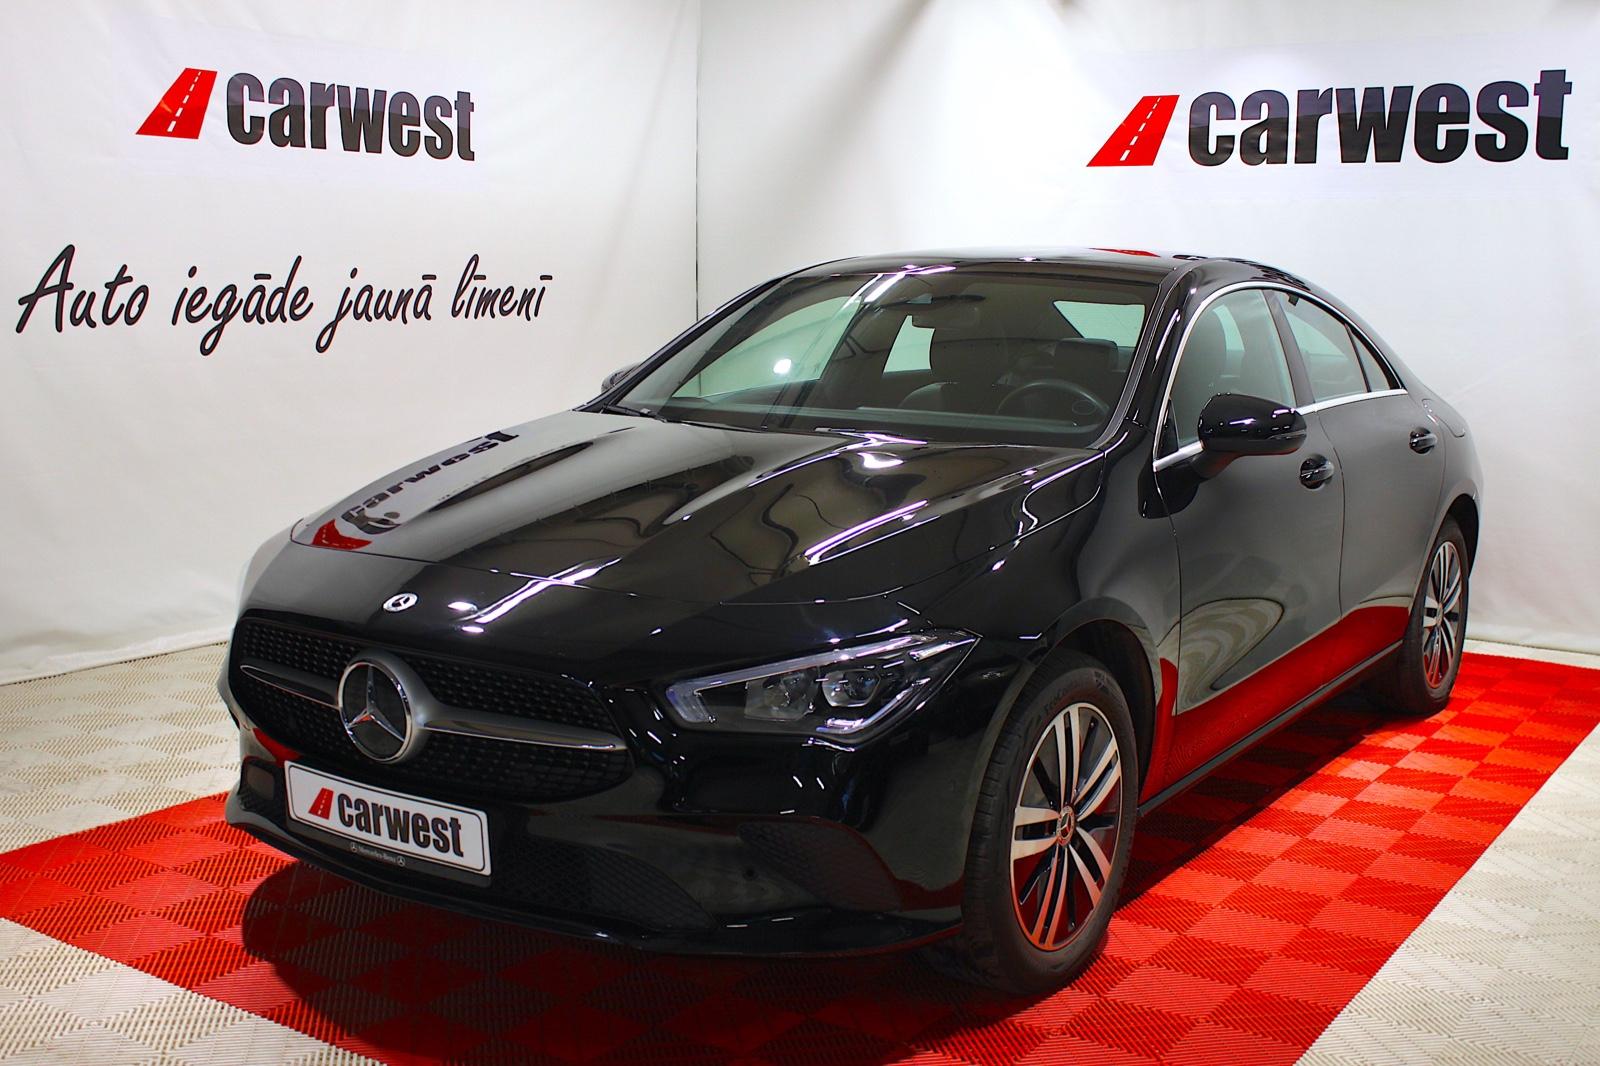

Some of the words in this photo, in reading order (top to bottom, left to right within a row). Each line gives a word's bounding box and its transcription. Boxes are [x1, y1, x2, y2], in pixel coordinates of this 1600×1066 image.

[226, 72, 475, 161] carwest
[1188, 69, 1573, 167] carwest
[15, 244, 150, 334] Auto
[171, 255, 314, 357] iegāde
[315, 267, 437, 354] jaunā
[450, 253, 553, 322] līmenī
[337, 793, 465, 858] carwest
